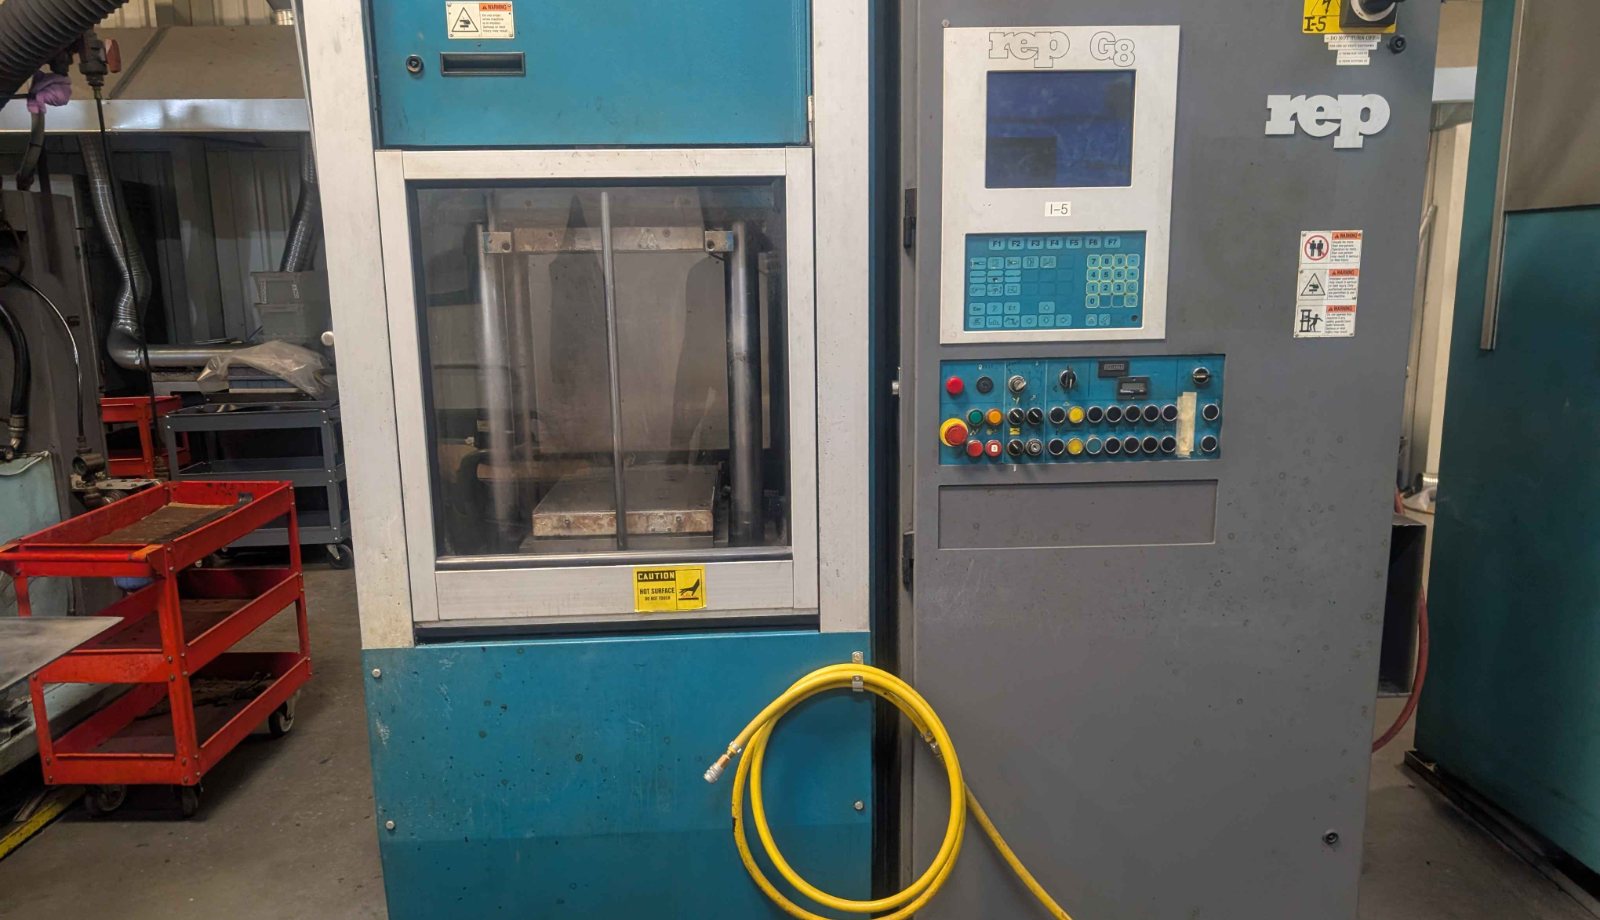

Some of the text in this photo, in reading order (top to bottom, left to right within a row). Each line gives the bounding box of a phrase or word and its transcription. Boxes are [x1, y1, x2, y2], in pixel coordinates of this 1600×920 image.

[1304, 16, 1327, 32] I-5
[989, 31, 1135, 68] rep G8
[1265, 94, 1390, 149] rep
[638, 572, 675, 580] CAUTION
